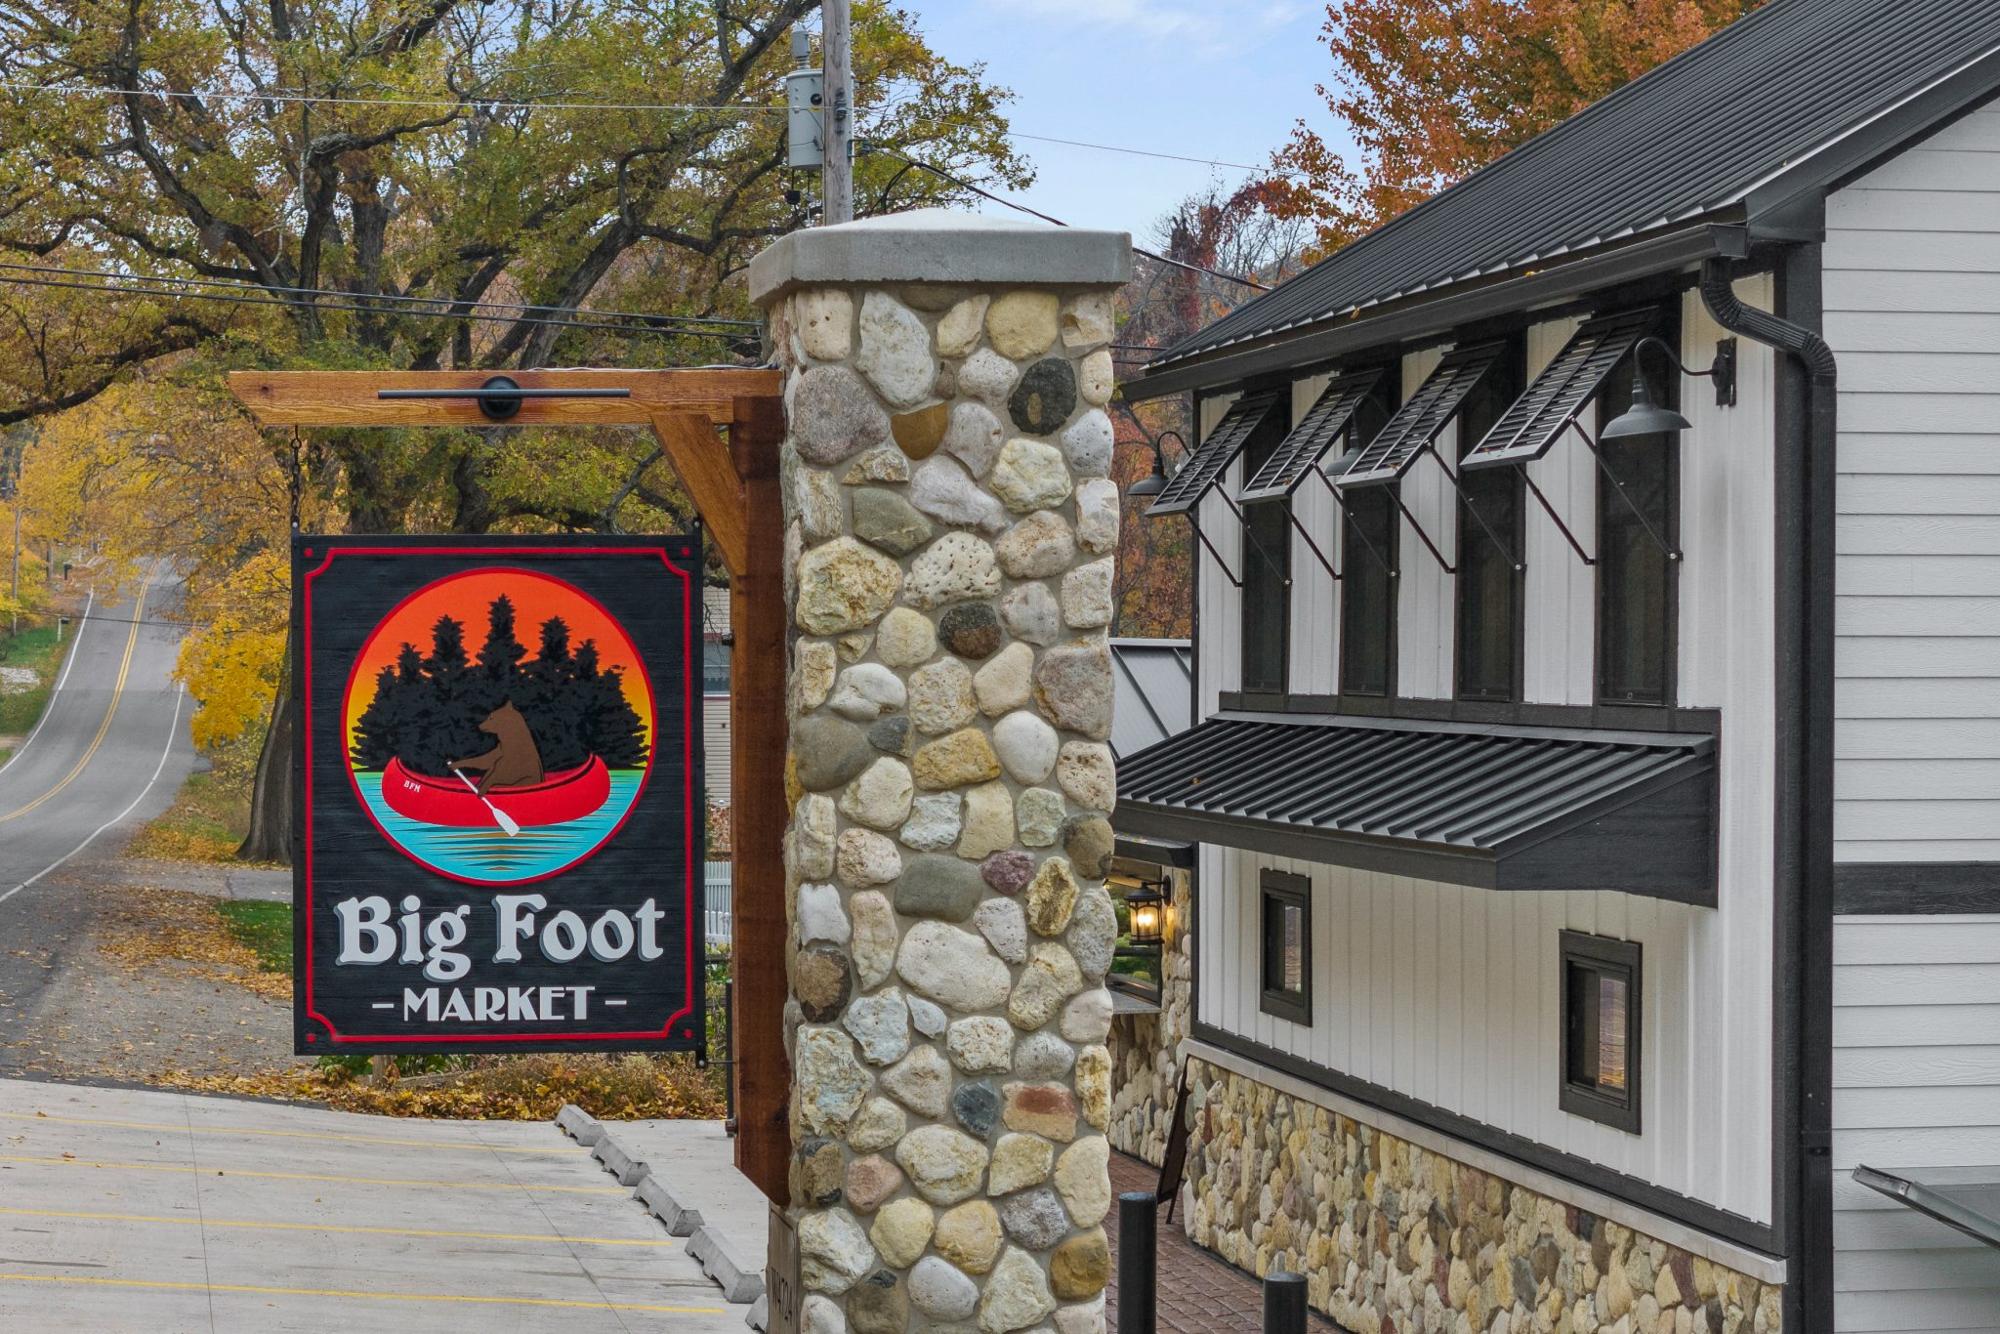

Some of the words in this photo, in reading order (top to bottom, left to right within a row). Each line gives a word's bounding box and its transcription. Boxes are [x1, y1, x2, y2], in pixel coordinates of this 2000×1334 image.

[333, 894, 472, 983] Big
[491, 893, 666, 964] Foot
[403, 986, 595, 1022] MARKET
